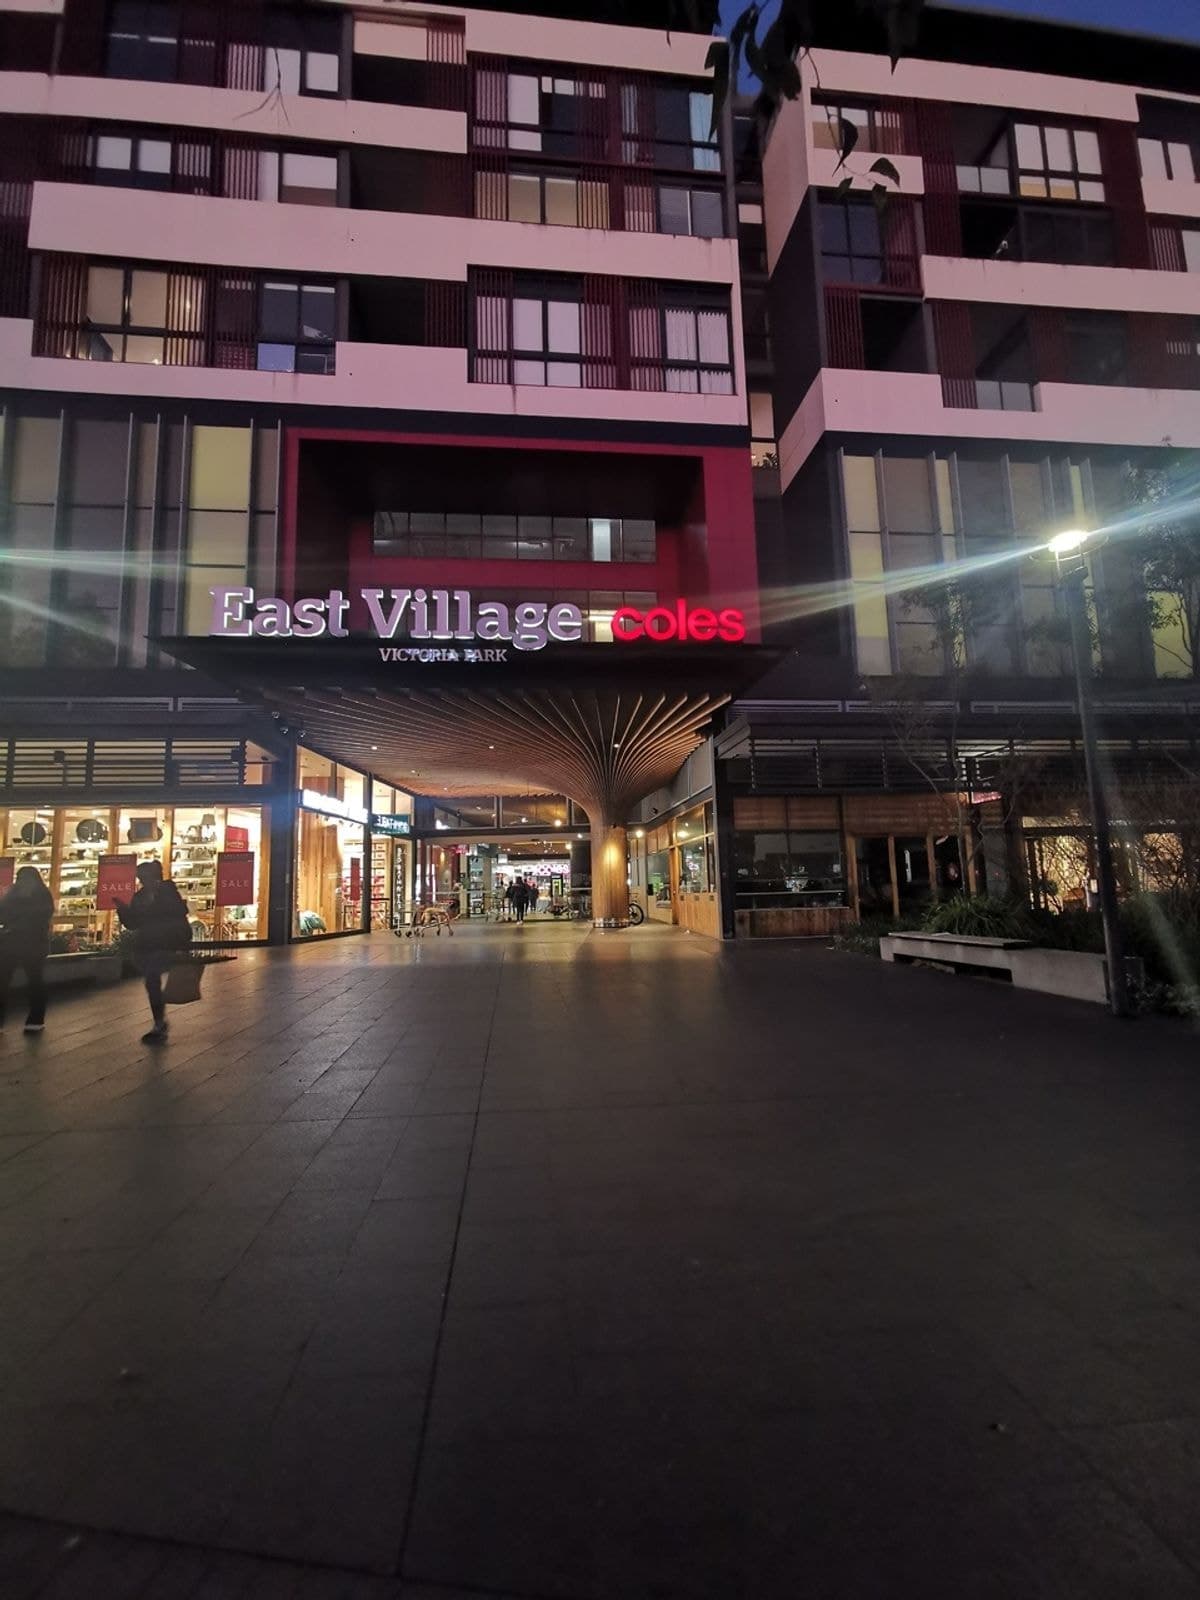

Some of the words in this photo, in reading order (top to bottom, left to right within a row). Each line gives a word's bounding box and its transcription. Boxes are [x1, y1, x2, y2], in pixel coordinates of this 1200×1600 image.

[208, 586, 350, 639] East
[361, 588, 583, 651] Village
[610, 598, 746, 643] coles
[379, 647, 460, 663] VICTORIA
[463, 648, 508, 663] PARK
[102, 882, 132, 892] SALE
[220, 879, 249, 888] SALE
